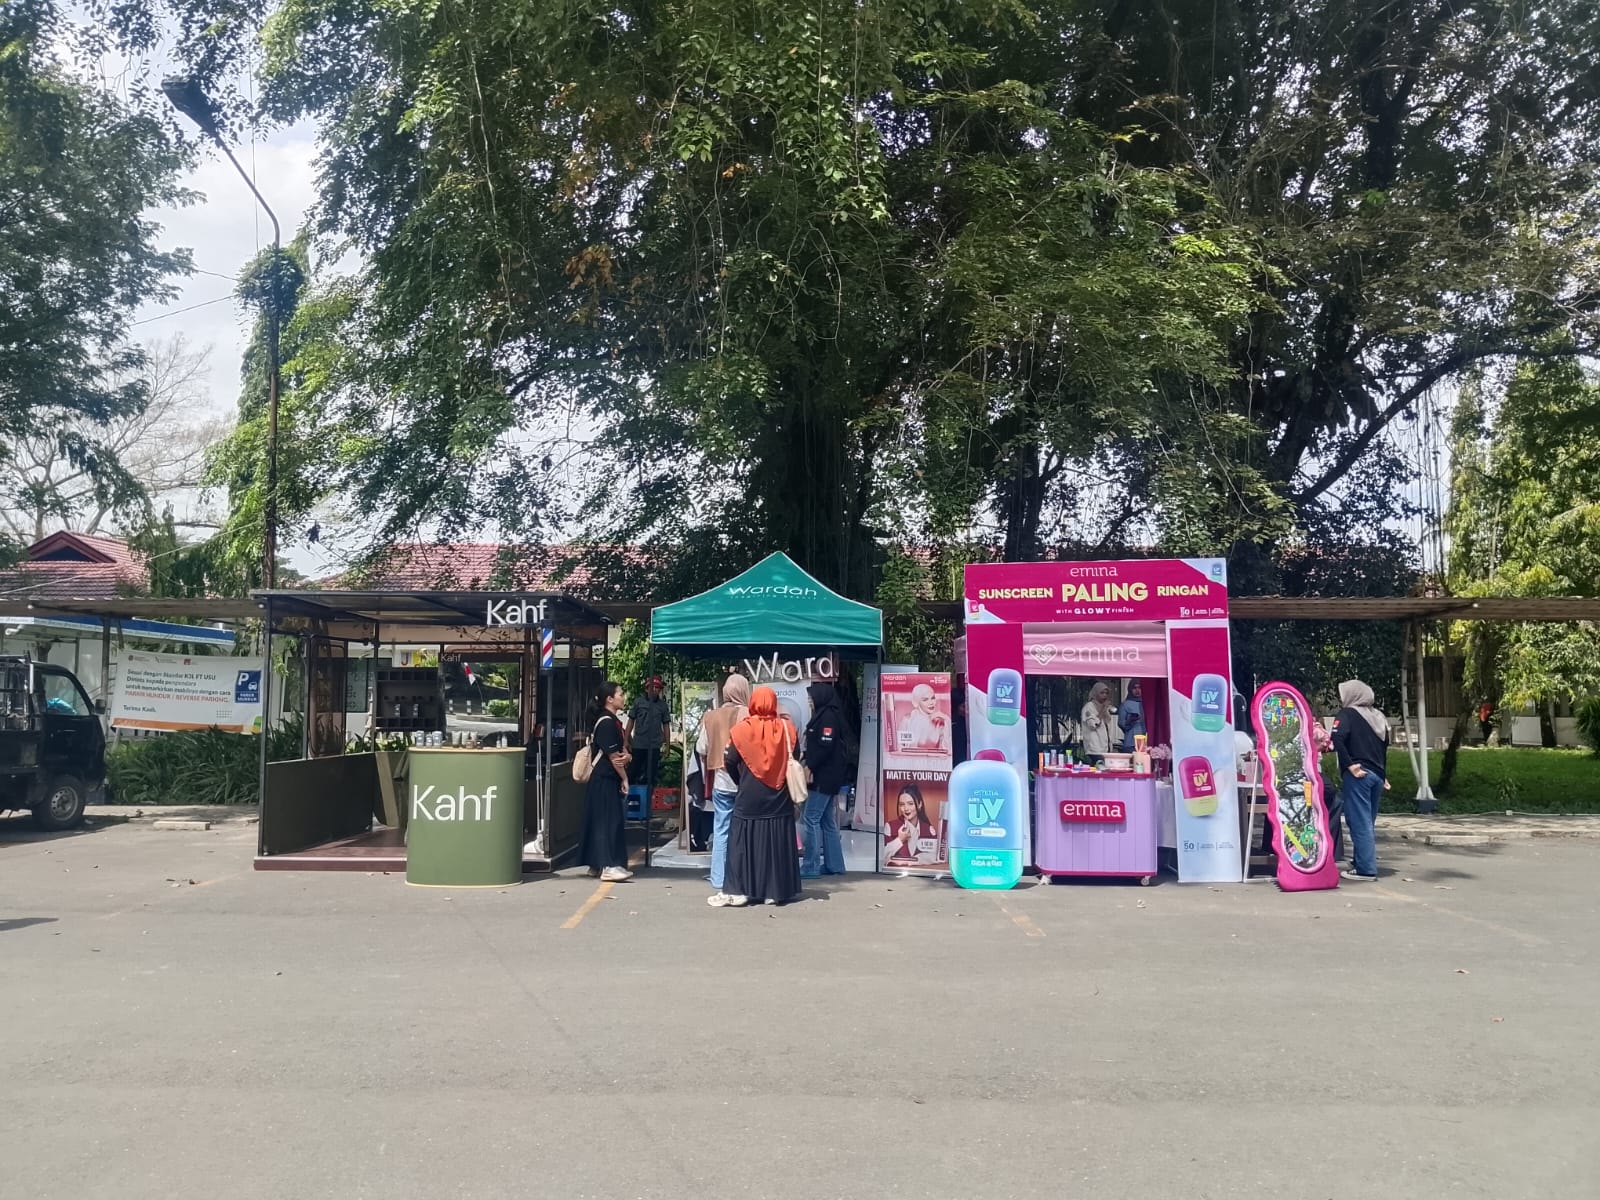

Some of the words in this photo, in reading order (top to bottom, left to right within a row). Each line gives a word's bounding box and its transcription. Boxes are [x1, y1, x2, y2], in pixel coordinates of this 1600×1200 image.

[1070, 566, 1118, 577] emina
[729, 585, 817, 596] wardah
[979, 587, 1053, 599] SUNSCREEN
[1062, 582, 1149, 602] PALING
[1157, 585, 1208, 596] RINGAN
[487, 599, 548, 625] Kahf
[1074, 607, 1111, 615] GLOWY
[440, 654, 462, 662] Kahf
[1062, 646, 1141, 662] emina
[238, 672, 250, 686] P
[775, 688, 797, 697] ardah
[996, 685, 1014, 698] UV
[1201, 690, 1219, 704] UV
[886, 770, 911, 780] MATTE
[912, 771, 933, 781] YOUR
[933, 773, 949, 782] DAY
[1193, 772, 1208, 787] UV
[412, 784, 498, 821] Kahf
[968, 798, 1005, 826] UV
[1063, 803, 1122, 817] emina
[1183, 842, 1194, 850] 50
